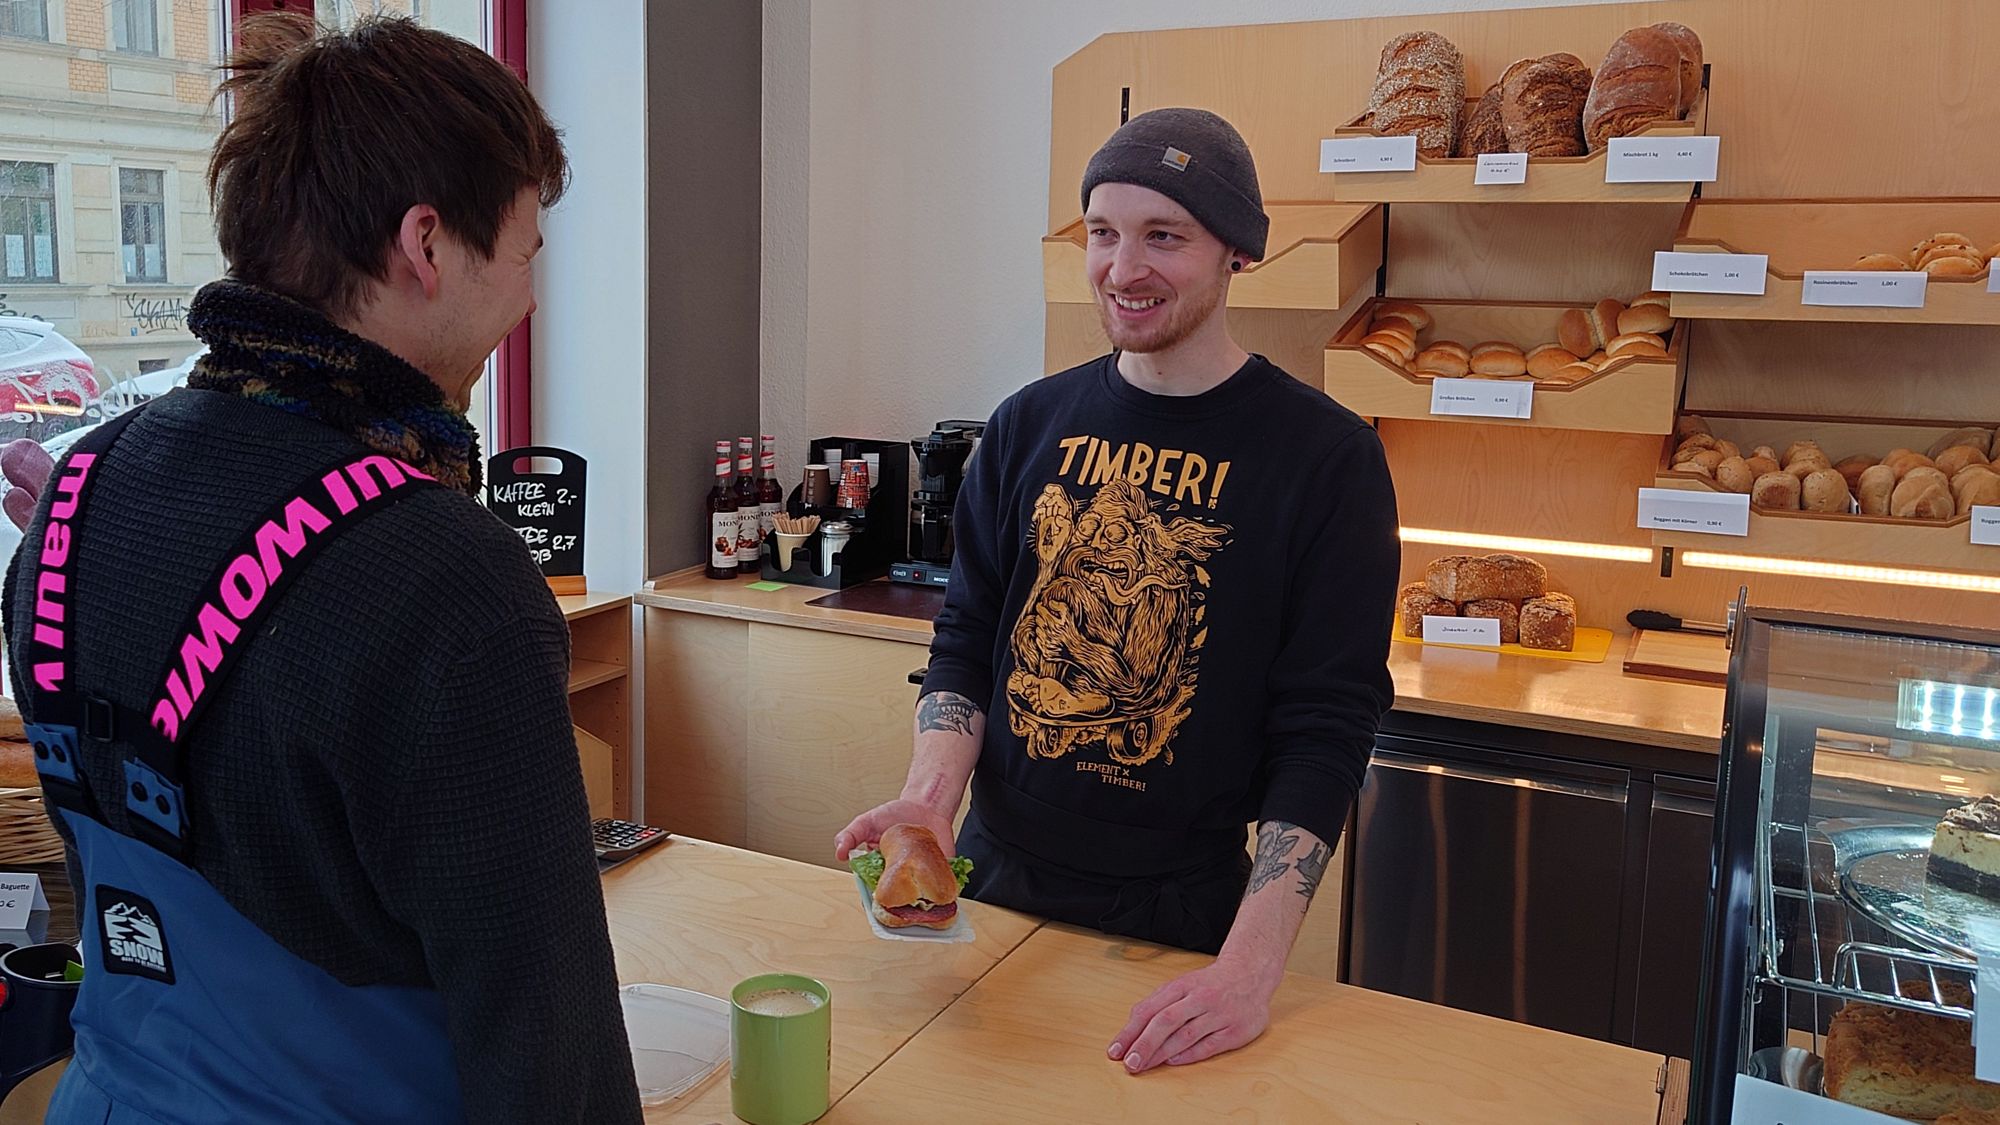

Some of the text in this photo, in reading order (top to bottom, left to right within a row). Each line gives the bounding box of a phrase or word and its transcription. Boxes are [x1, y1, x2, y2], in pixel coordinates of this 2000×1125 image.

[1058, 434, 1231, 510] TIMBER!
[493, 481, 546, 503] KAFFEE
[1076, 760, 1122, 776] ELEMENT
[1101, 774, 1147, 792] TIMBER!
[0, 883, 30, 891] Baguette
[109, 939, 165, 967] SNOW
